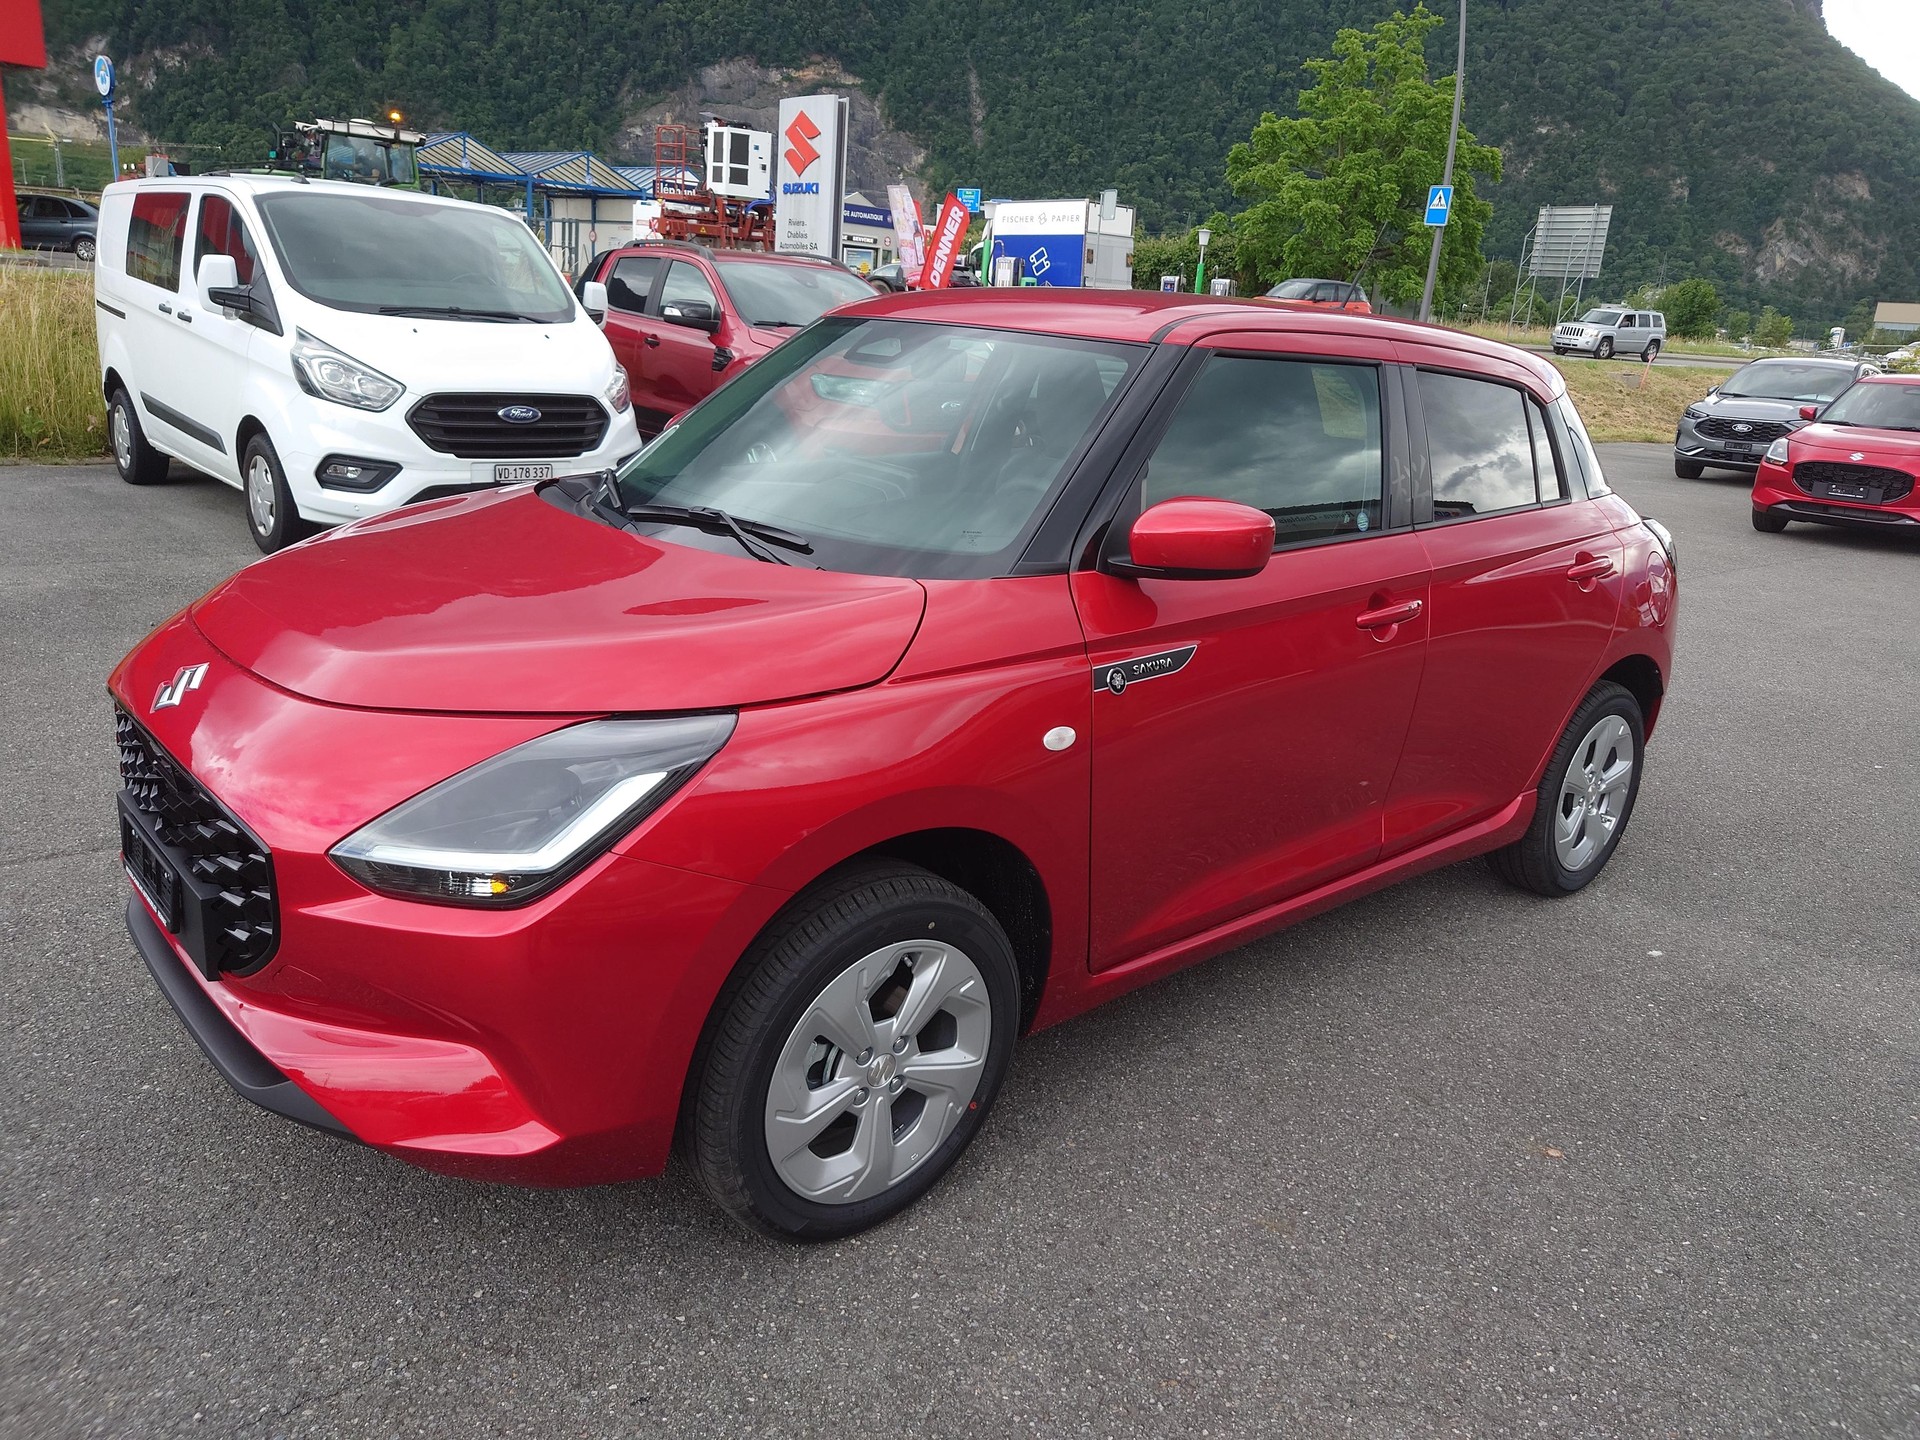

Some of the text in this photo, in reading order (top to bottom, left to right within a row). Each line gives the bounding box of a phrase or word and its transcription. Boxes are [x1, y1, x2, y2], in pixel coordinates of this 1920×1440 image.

[783, 183, 819, 194] SUZUKI
[851, 211, 884, 222] AUTOMATIQUE
[1002, 214, 1080, 223] FISCHER PAPIER
[787, 230, 808, 239] Chablais
[780, 241, 818, 251] Automobiles SA
[930, 206, 964, 288] DENNER
[510, 408, 533, 419] Ford
[1133, 657, 1173, 675] SAKURA
